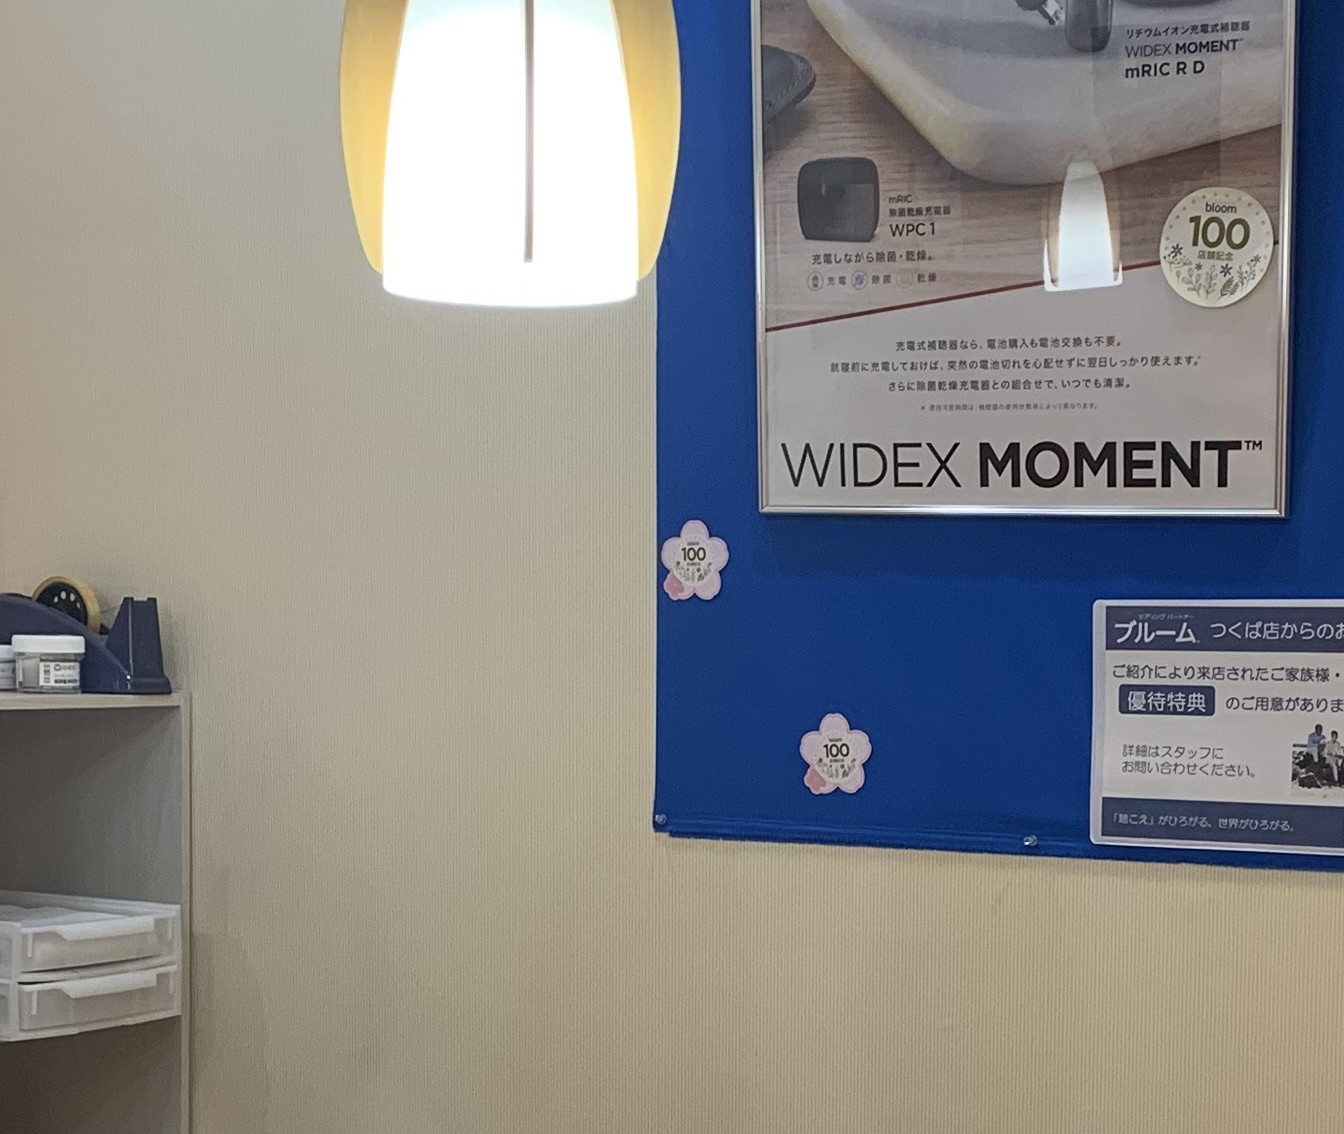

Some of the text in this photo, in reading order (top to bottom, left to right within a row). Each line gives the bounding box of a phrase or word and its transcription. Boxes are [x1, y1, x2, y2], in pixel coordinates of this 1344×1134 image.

[1125, 43, 1173, 58] WIDEX
[1125, 60, 1205, 78] mRIC R D
[1205, 202, 1237, 213] bloom
[889, 223, 926, 237] WPC
[1189, 215, 1250, 250] 100
[781, 442, 961, 488] WIDEX
[681, 547, 706, 561] 100
[1127, 690, 1206, 713] 優待特典
[823, 743, 849, 757] 100
[1121, 744, 1224, 760] 詳細はスタッフに
[1121, 760, 1256, 779] お問い合わせください。
